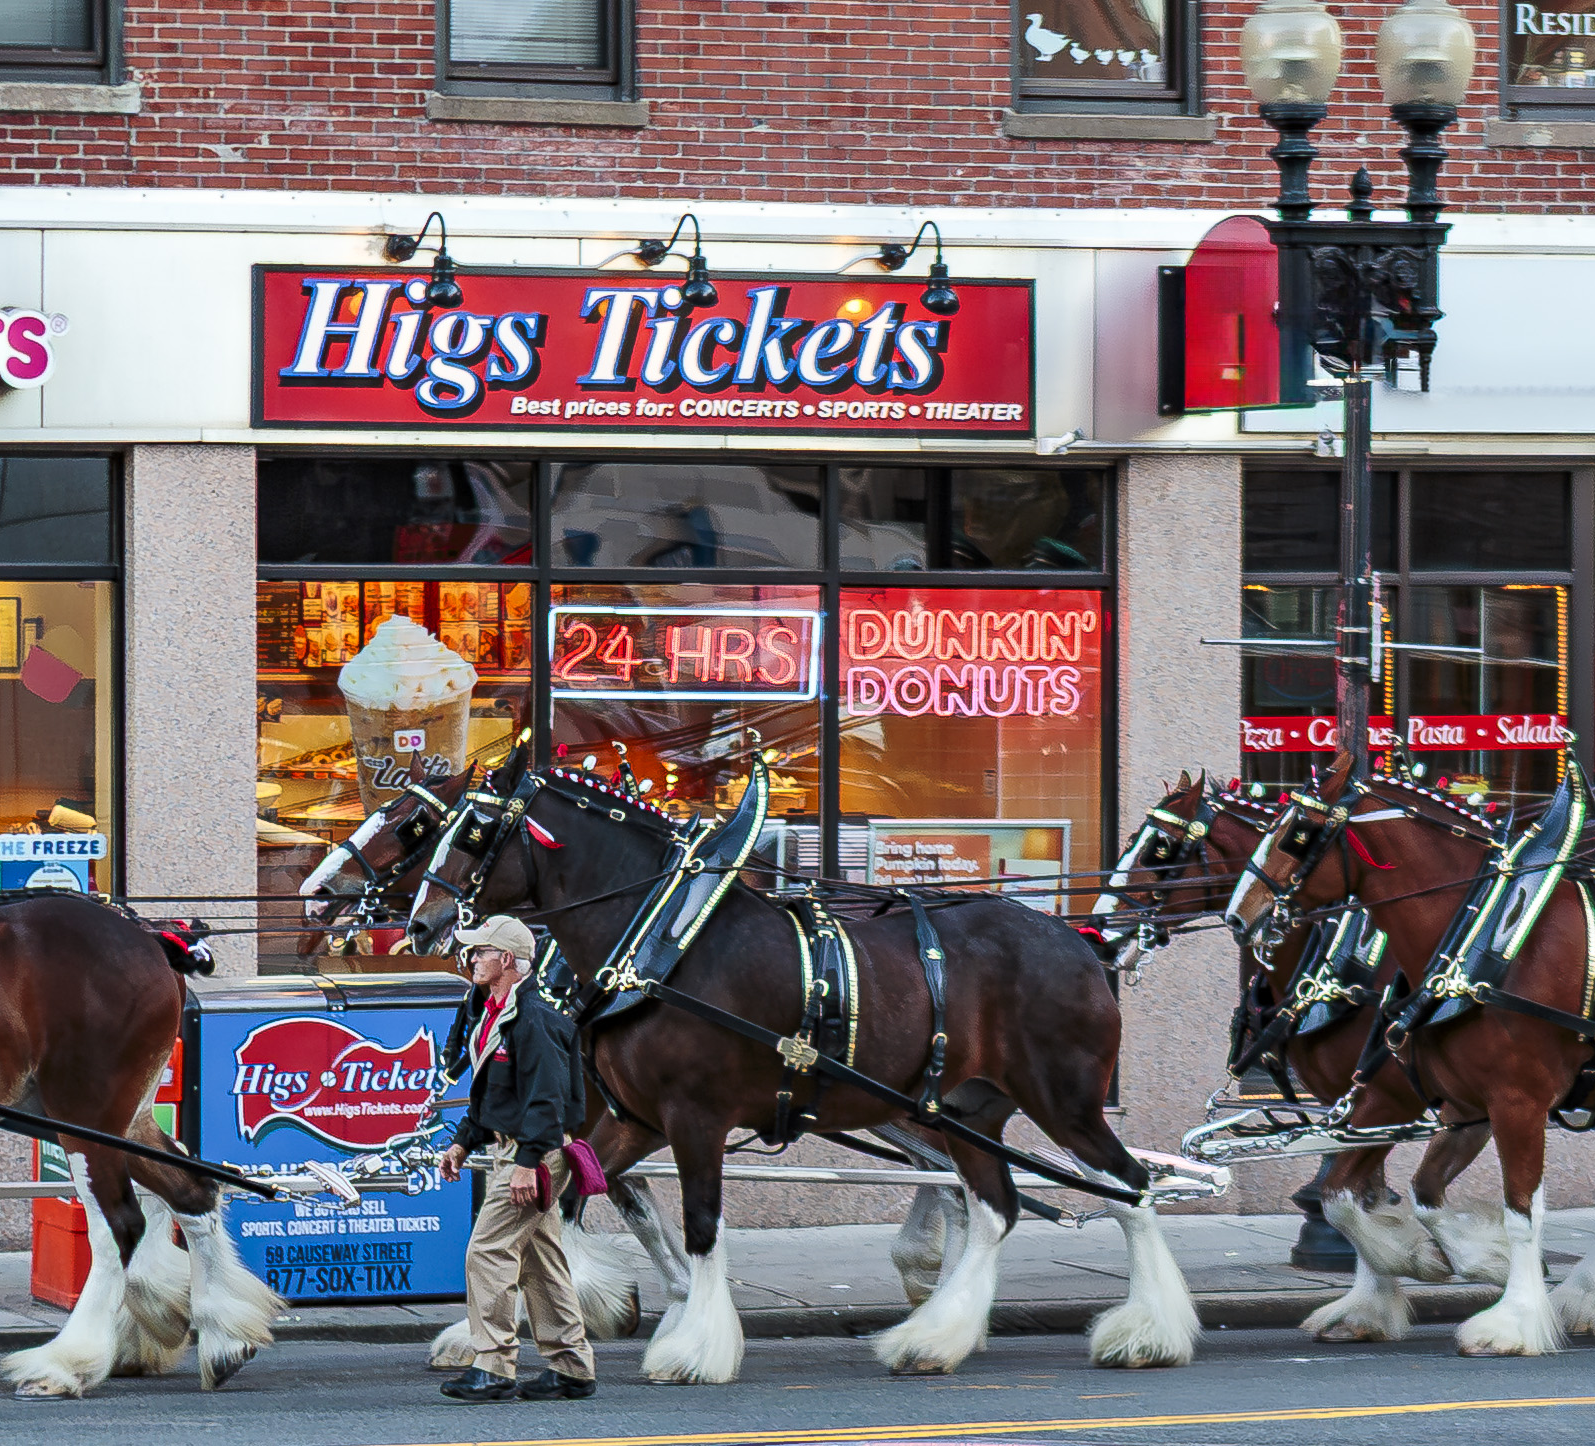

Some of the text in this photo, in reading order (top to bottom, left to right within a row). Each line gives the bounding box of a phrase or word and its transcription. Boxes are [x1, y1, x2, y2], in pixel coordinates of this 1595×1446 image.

[280, 278, 940, 410] Higs Tickets
[510, 396, 1024, 422] Best prices for: CONCERTS SPORTS THEATER
[559, 621, 799, 685] 24 HRS
[846, 609, 1098, 717] DUNKIN' DONUTS
[1407, 717, 1467, 746] Pasta
[32, 839, 101, 856] FREEZE
[874, 840, 955, 858] Bring home
[874, 856, 936, 874] Pumpkin
[228, 1059, 447, 1102] Higs Tickets
[303, 1102, 429, 1119] www.HigsTickets.com
[361, 1199, 389, 1217] SELL
[287, 1218, 336, 1236] CONCERT
[337, 1218, 348, 1235] &
[348, 1217, 396, 1235] THEATER
[397, 1215, 441, 1233] TICKETS
[286, 1243, 358, 1264] CAUSEWAY
[361, 1240, 414, 1261] STREET
[265, 1263, 413, 1296] 877-SOX-TIXX
